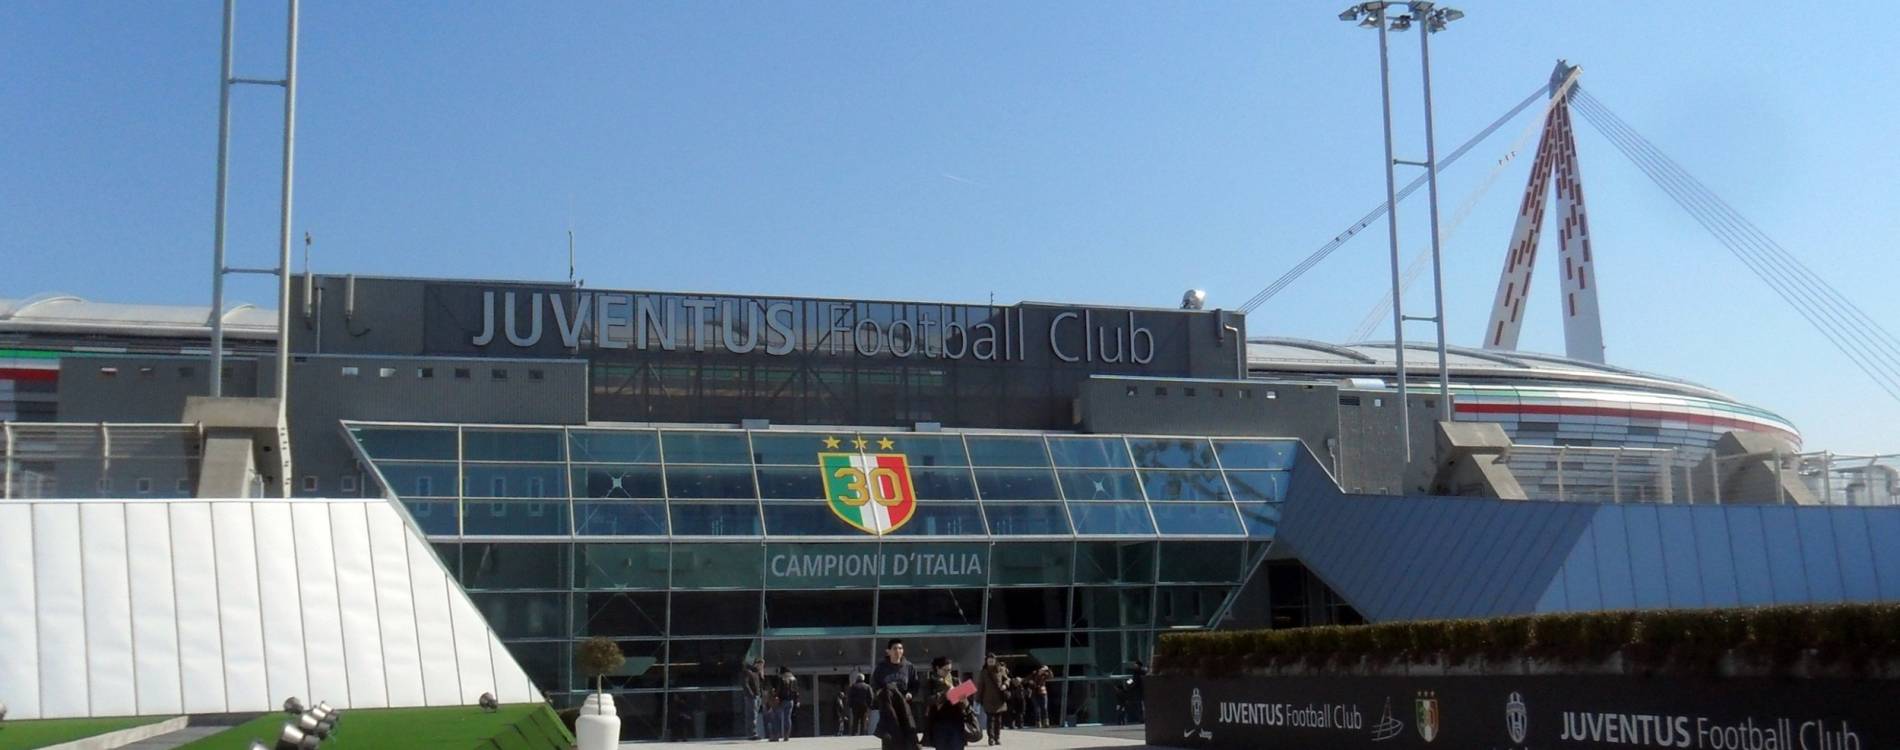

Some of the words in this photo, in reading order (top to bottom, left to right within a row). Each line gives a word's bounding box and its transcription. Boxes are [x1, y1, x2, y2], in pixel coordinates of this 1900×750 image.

[472, 290, 796, 355] JUVENTUS
[829, 303, 1025, 360] Football
[1051, 309, 1155, 363] Club
[834, 467, 904, 506] 30
[771, 554, 885, 576] CAMPIONI
[1218, 702, 1284, 726] JUVENTUS
[1286, 704, 1331, 727] Football
[1333, 704, 1363, 730] Club
[1560, 711, 1691, 748] JUVENTUS
[1698, 716, 1791, 750] Football
[1800, 719, 1860, 750] Club
